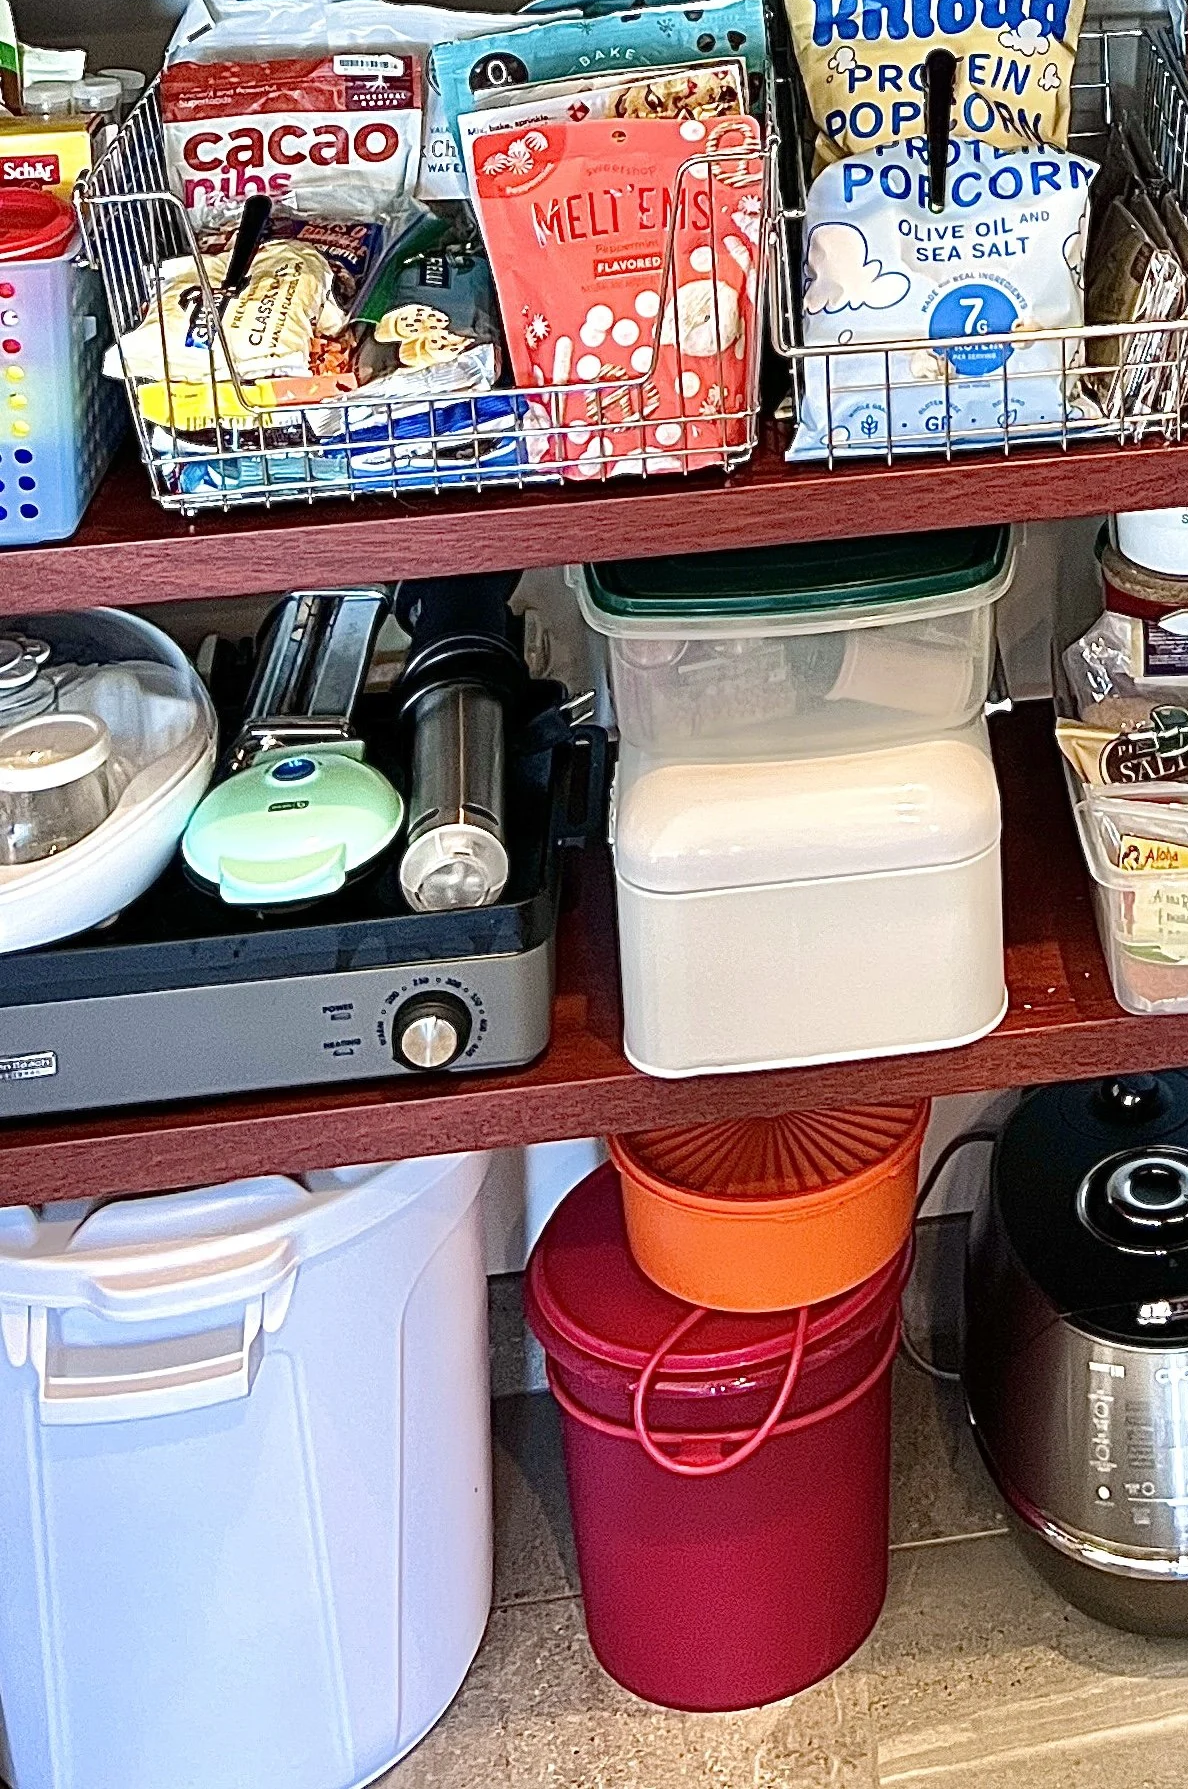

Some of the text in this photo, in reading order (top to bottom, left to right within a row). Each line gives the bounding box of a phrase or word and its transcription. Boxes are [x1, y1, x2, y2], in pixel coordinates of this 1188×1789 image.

[578, 47, 636, 67] BAKE
[848, 52, 1030, 94] PROEIN
[489, 122, 513, 132] bake,
[826, 92, 1041, 140] POPORN
[184, 123, 399, 171] cacao
[2, 160, 55, 181] Schär
[184, 166, 292, 209] nibs
[899, 211, 1050, 241] OLIVE OIL AND
[916, 237, 1030, 262] SEA SALT
[597, 257, 661, 273] FLAVORED
[921, 272, 1028, 312] MADE REAL INGREDIENTS
[1144, 847, 1178, 863] Aloha
[322, 1003, 353, 1013] POWER
[323, 1038, 361, 1049] HEATING
